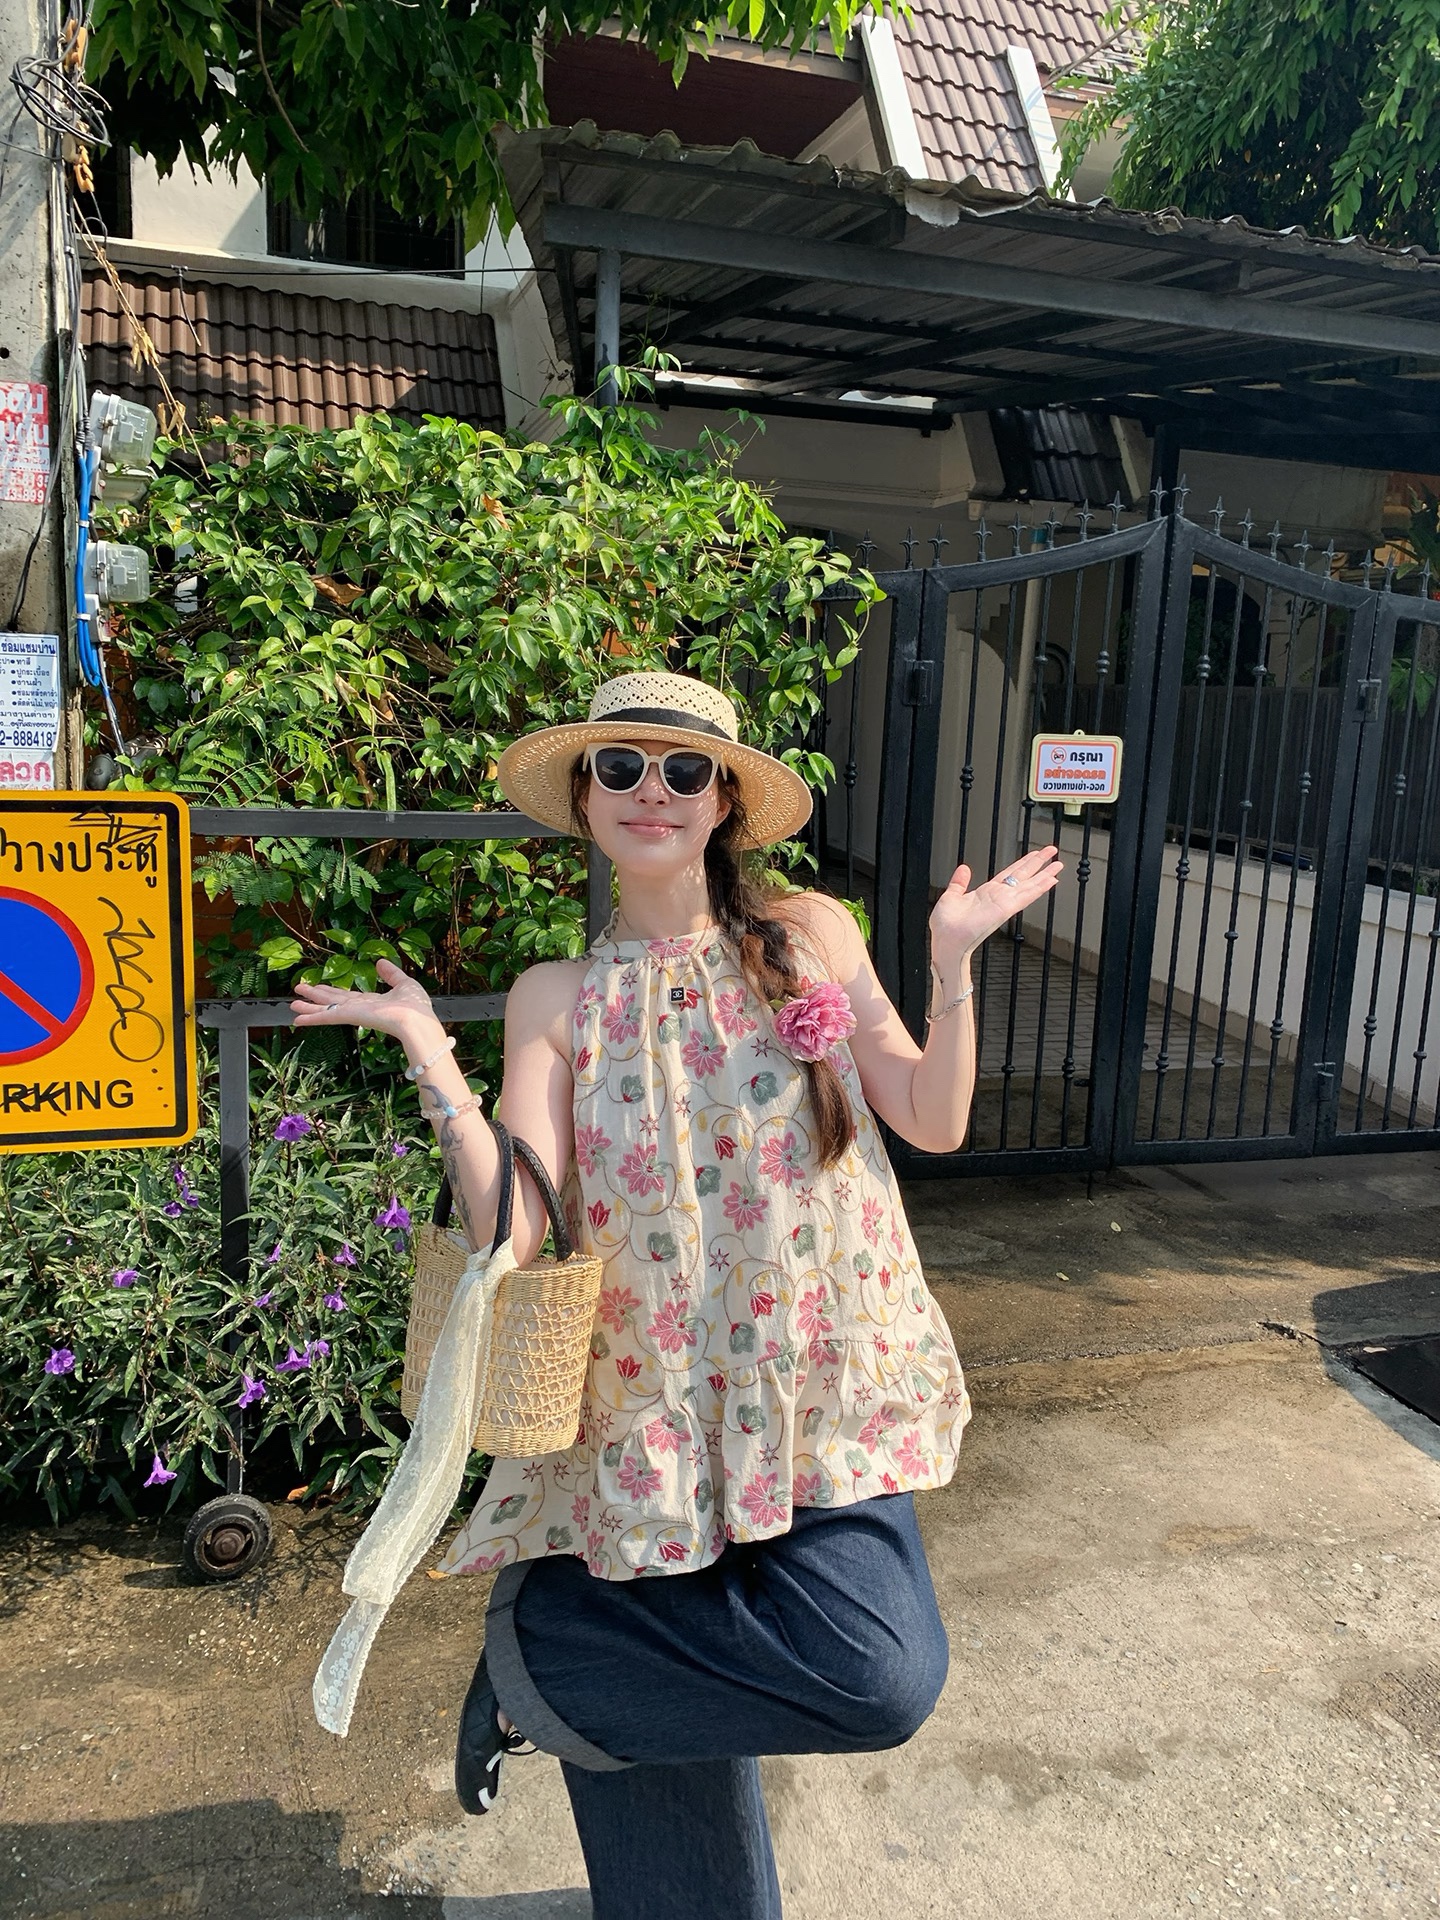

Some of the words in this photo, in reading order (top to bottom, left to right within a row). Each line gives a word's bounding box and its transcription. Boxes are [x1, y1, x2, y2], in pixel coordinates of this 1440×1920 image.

[1070, 752, 1103, 765] กรุณา
[1044, 766, 1106, 779] อย่าจอดรถ
